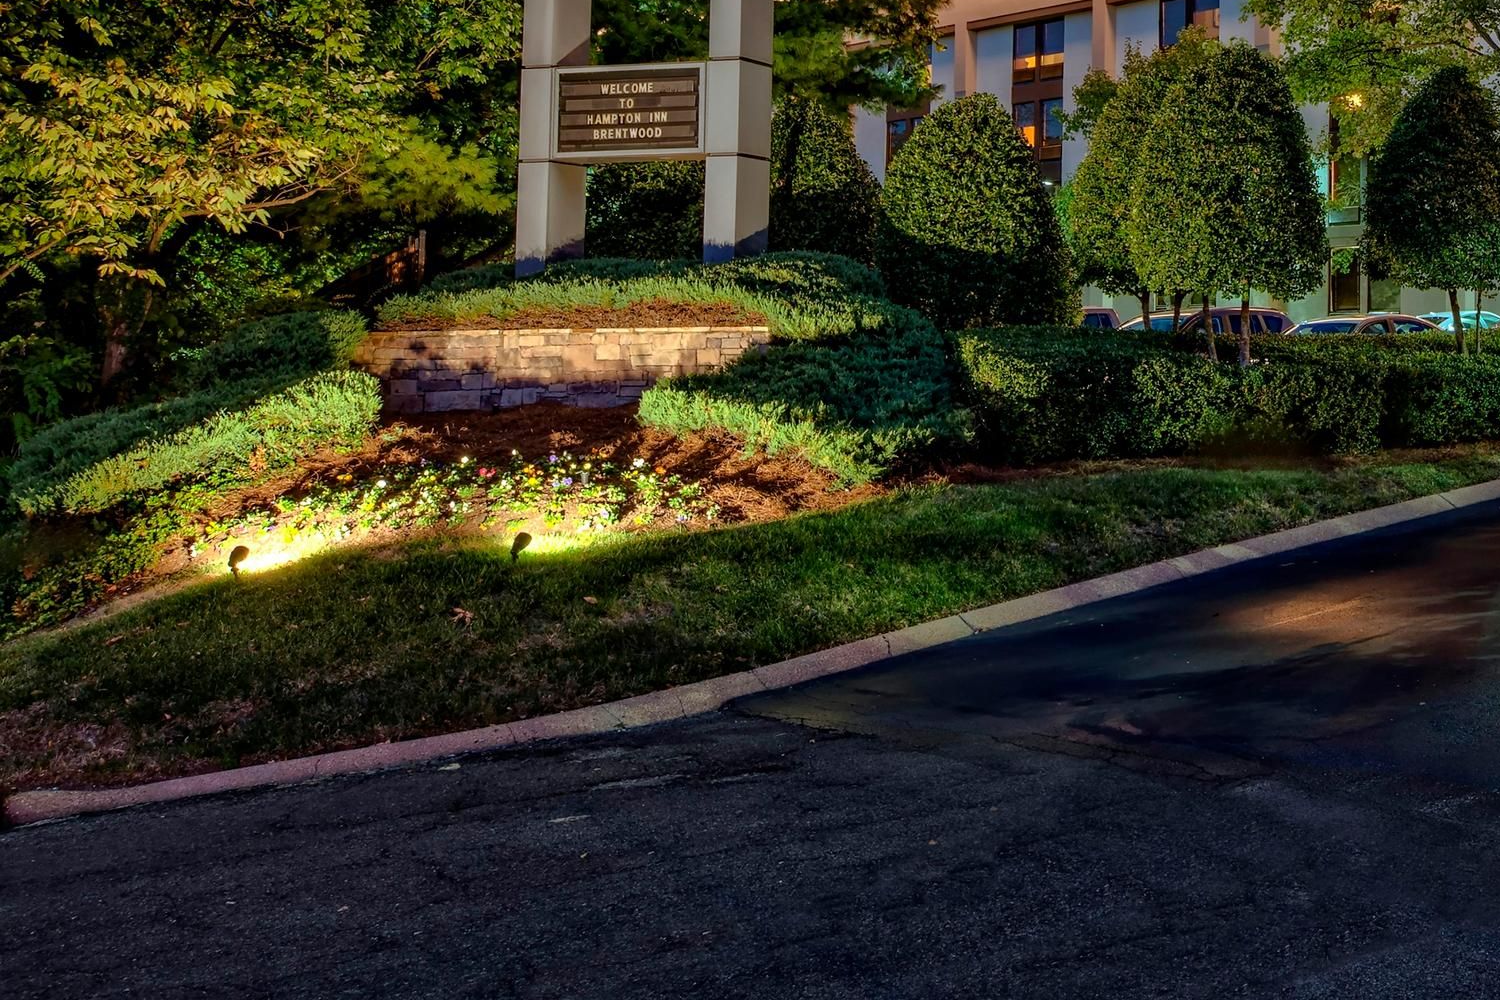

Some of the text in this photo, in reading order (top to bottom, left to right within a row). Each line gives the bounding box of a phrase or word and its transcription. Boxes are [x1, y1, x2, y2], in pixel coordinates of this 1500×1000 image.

[601, 82, 653, 95] WELCOME
[619, 98, 634, 108] TO
[587, 111, 668, 125] HAMPTON INN
[593, 127, 662, 140] BRENTWOOD
